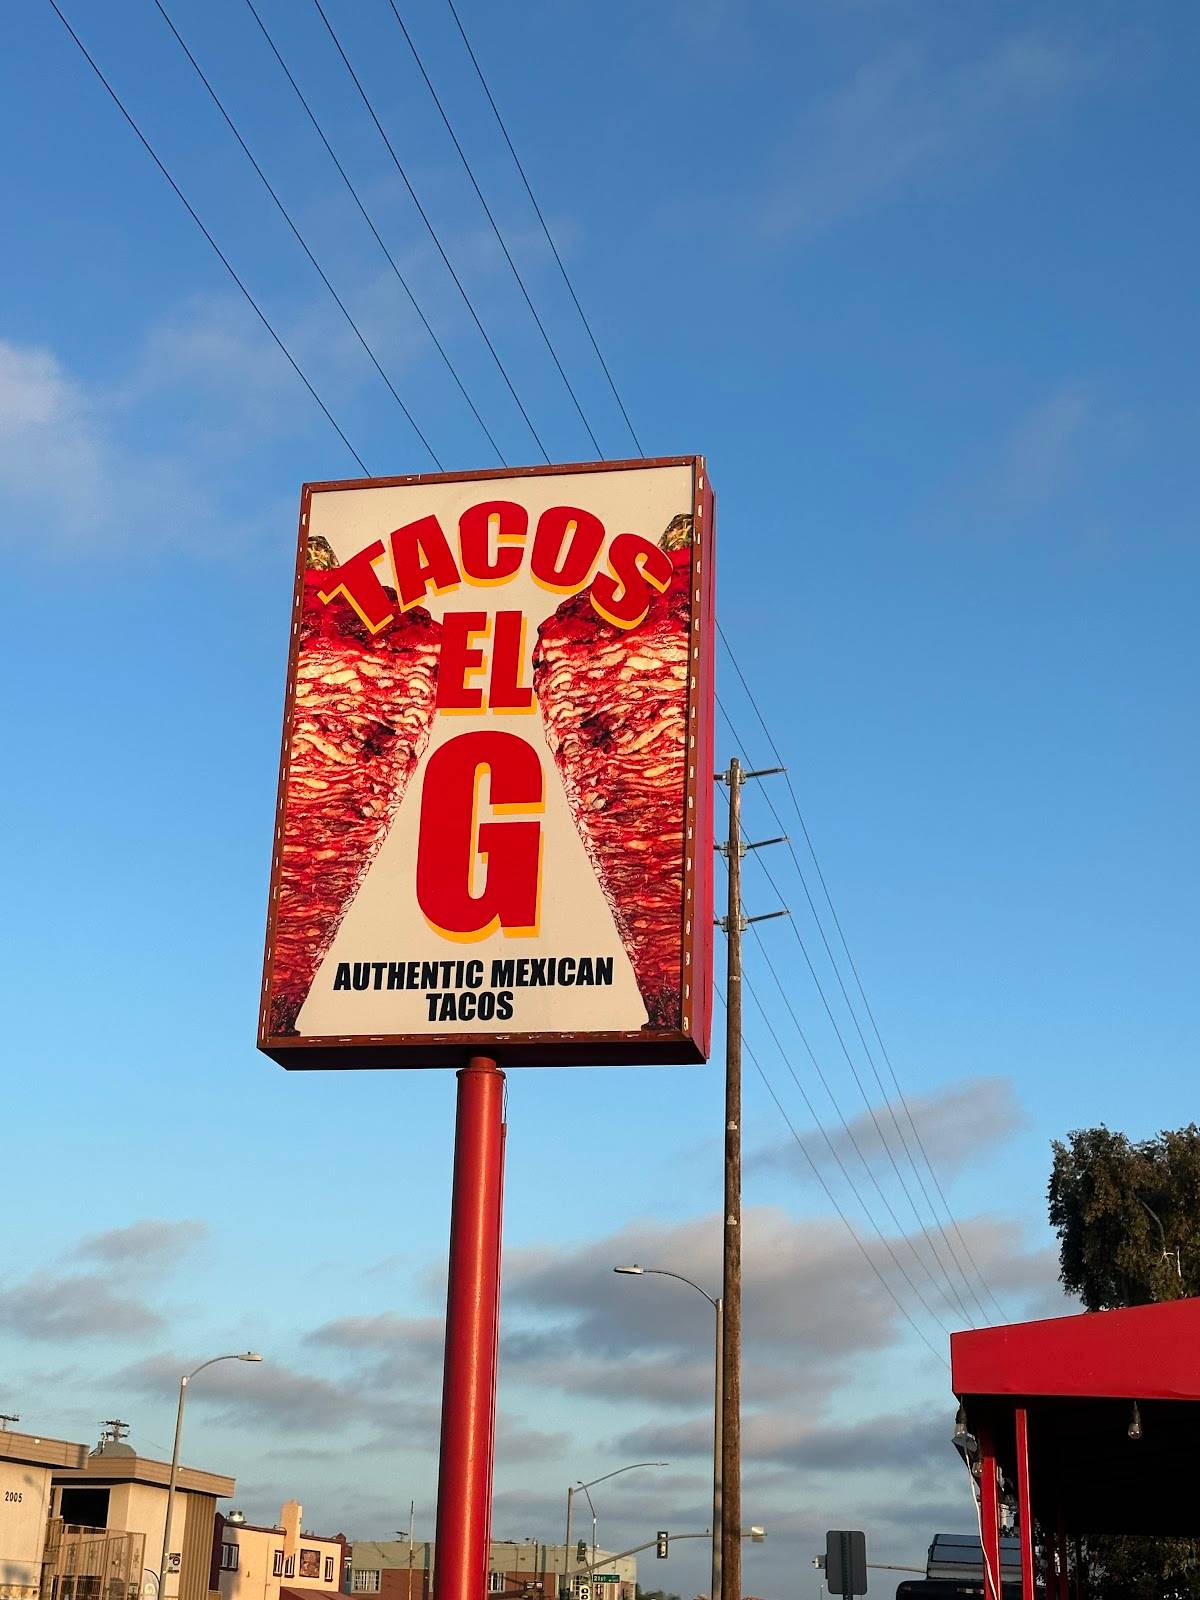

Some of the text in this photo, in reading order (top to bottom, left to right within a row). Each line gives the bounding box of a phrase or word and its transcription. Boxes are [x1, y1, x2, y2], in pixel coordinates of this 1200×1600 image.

[318, 500, 674, 635] TACOS
[435, 610, 538, 716] EL
[416, 731, 546, 944] G
[333, 957, 614, 992] AUTHENTIC MEXICAN
[426, 990, 514, 1022] TACOS
[5, 1490, 23, 1503] 2005
